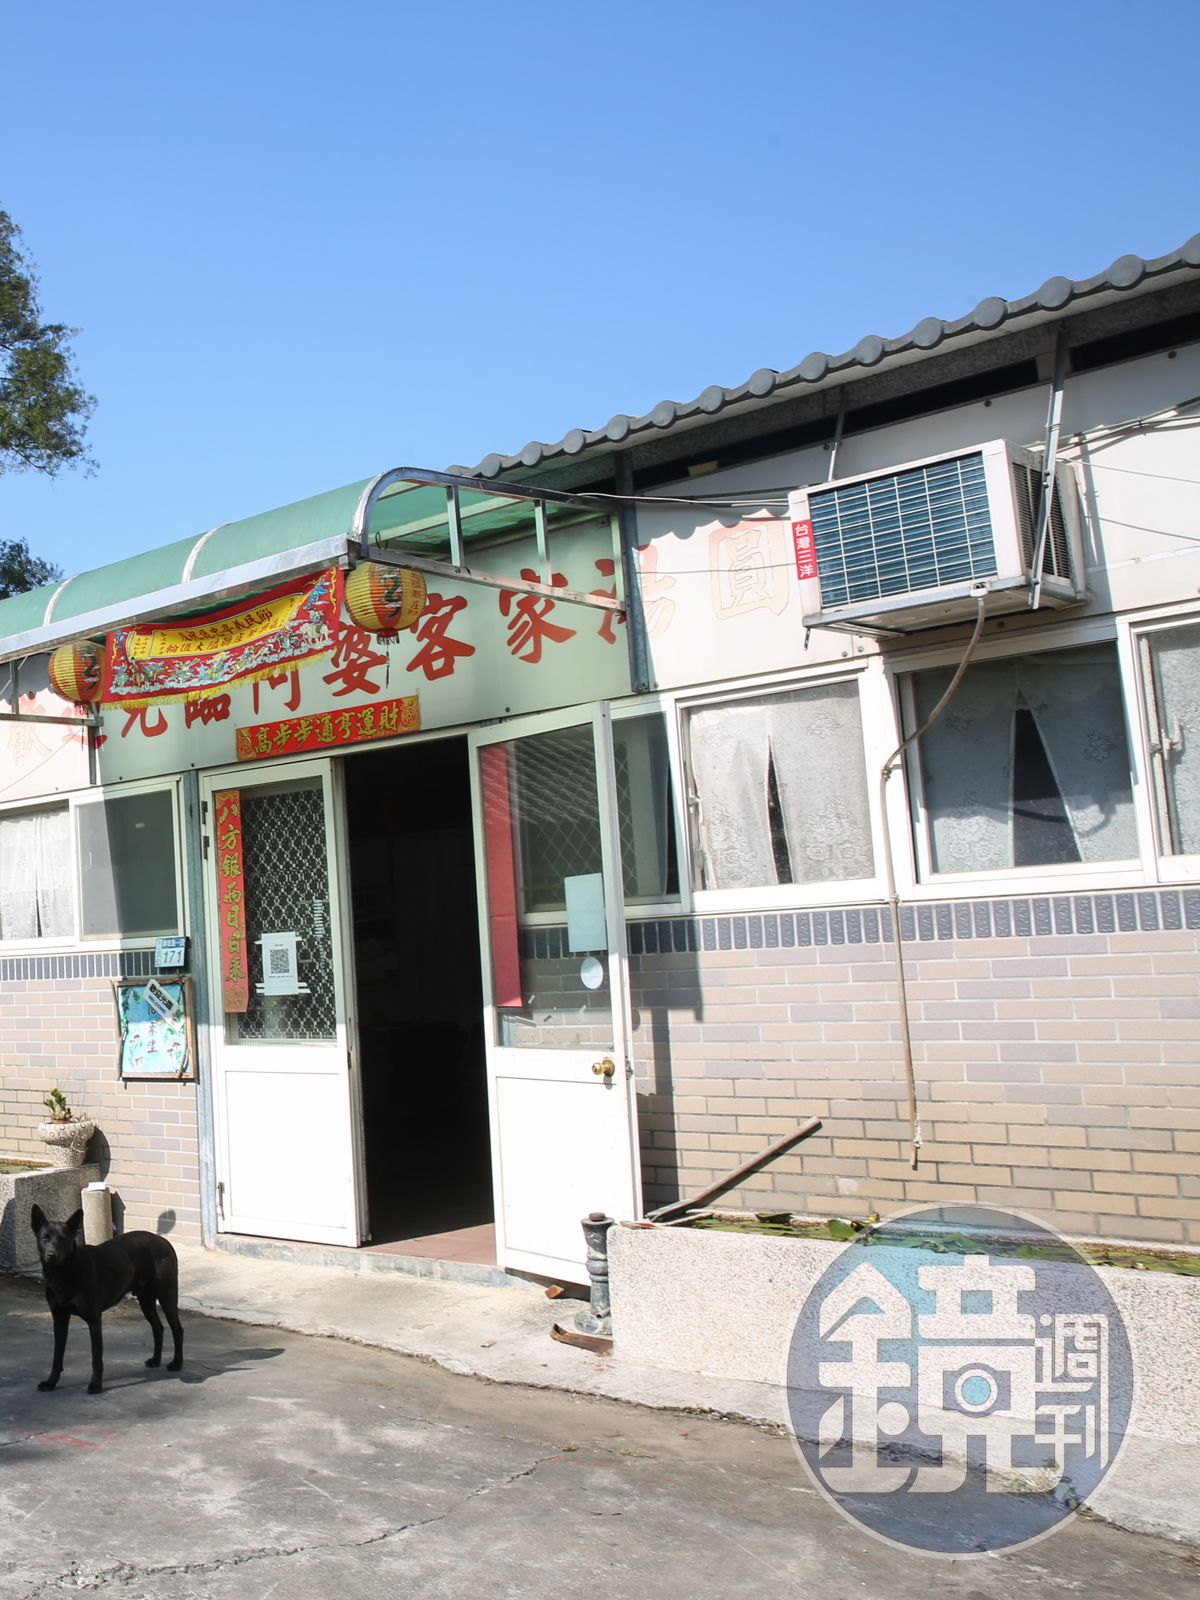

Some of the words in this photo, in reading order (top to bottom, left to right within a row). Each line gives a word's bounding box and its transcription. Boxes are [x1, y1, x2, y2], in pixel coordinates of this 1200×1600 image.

[794, 523, 814, 578] 台灣三洋
[163, 949, 182, 964] 171
